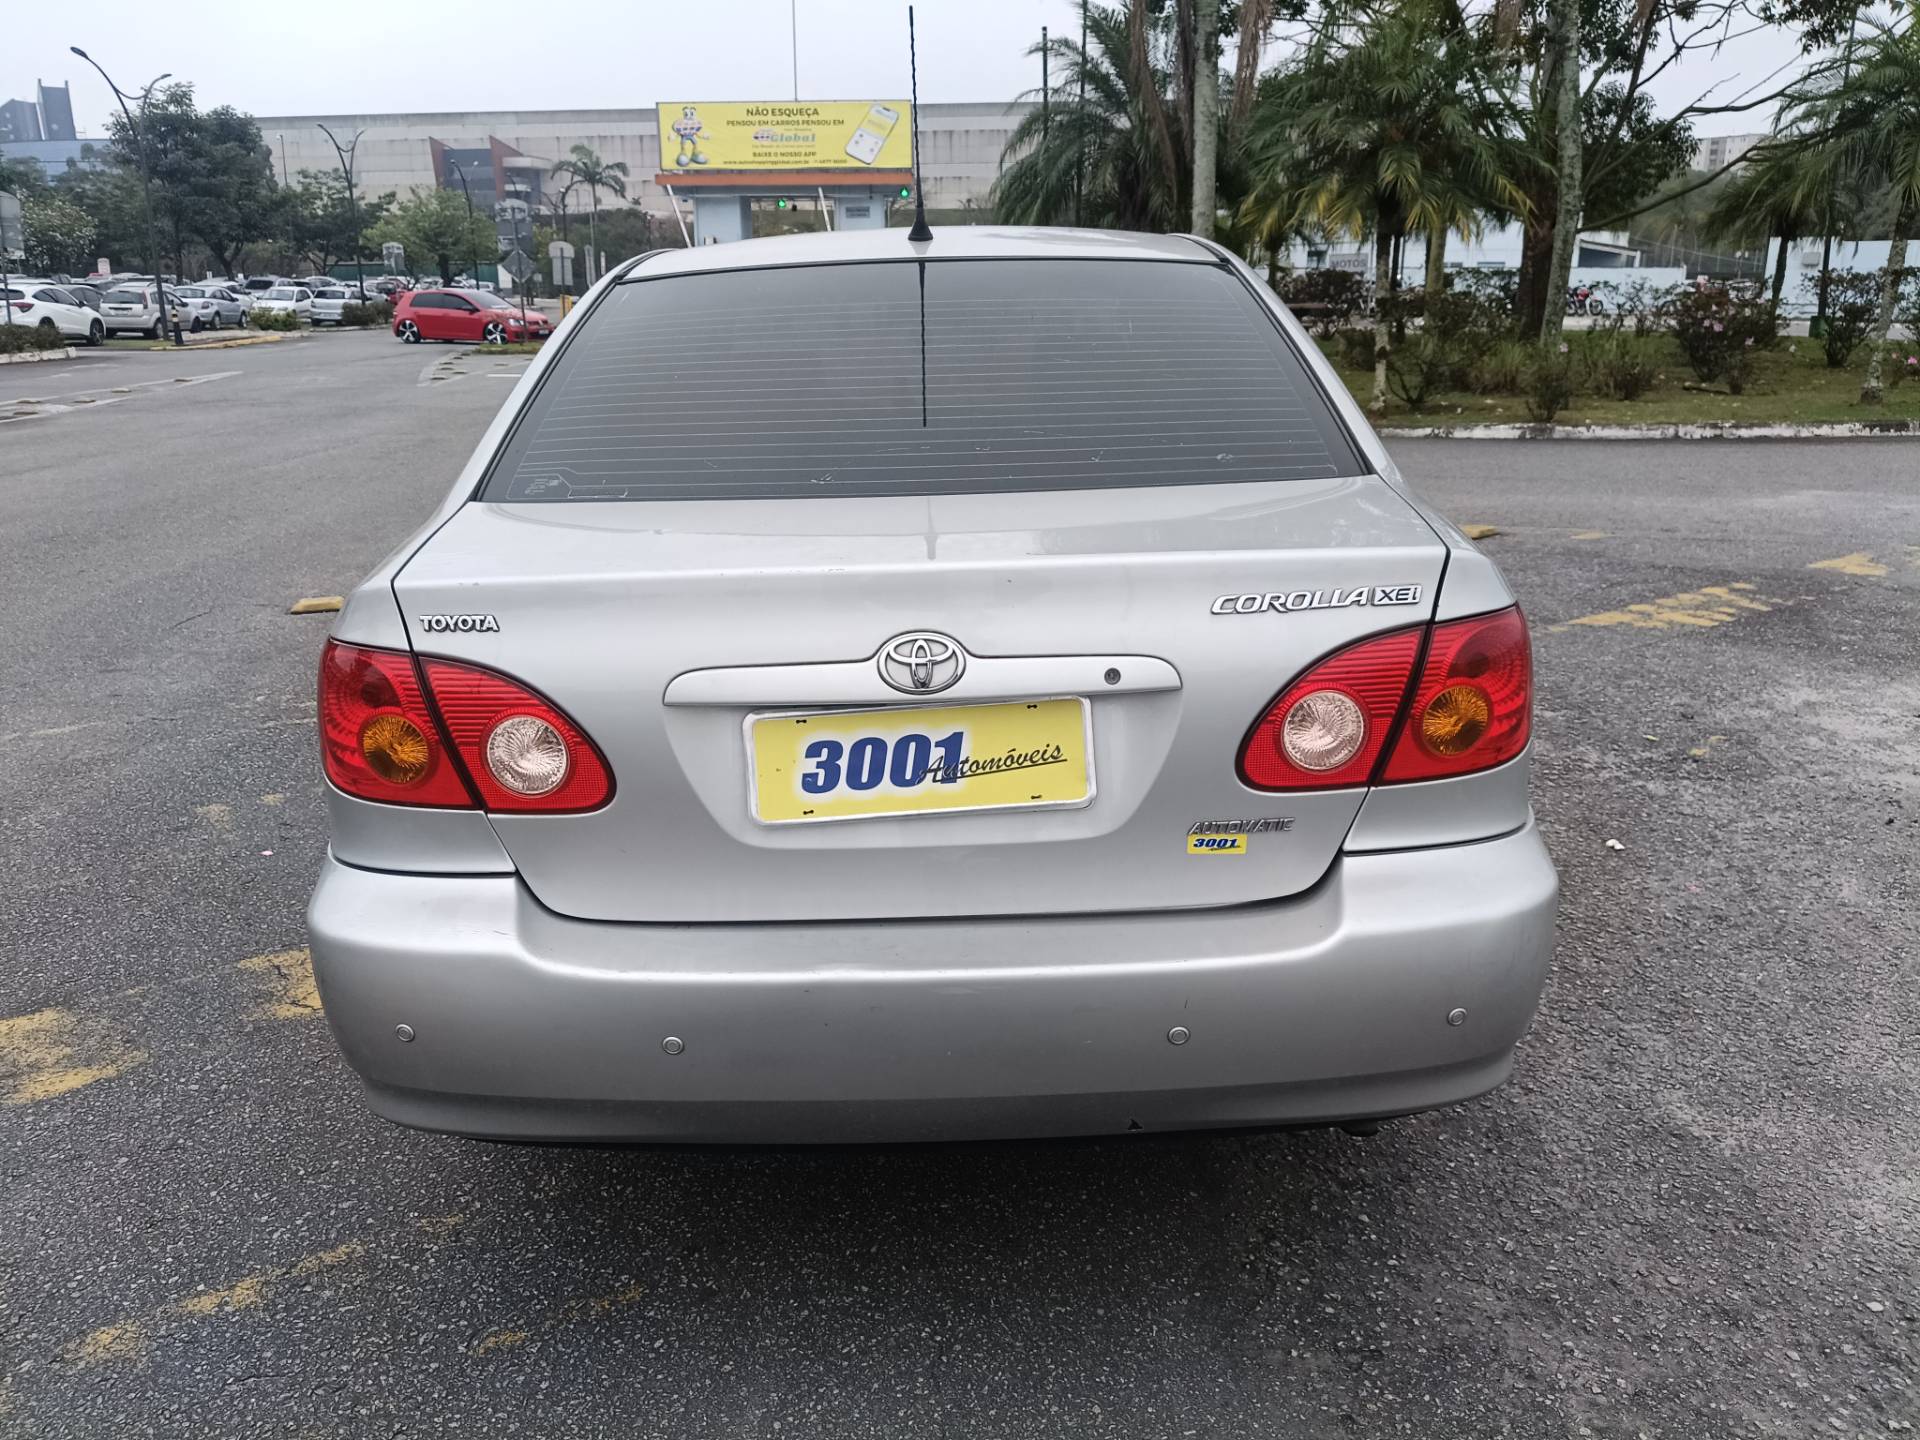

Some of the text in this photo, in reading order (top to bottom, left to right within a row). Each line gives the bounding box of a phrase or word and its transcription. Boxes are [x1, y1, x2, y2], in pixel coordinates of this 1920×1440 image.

[746, 107, 820, 118] NÃO ESQUEÇA
[770, 133, 816, 142] Global
[1330, 260, 1367, 268] MOTOS
[1210, 586, 1370, 615] COROLLA
[419, 614, 500, 632] TOYOTA
[801, 731, 1064, 794] 3001 Automóveis
[1187, 818, 1295, 834] AUTOMATIC
[1193, 838, 1238, 849] 3001
